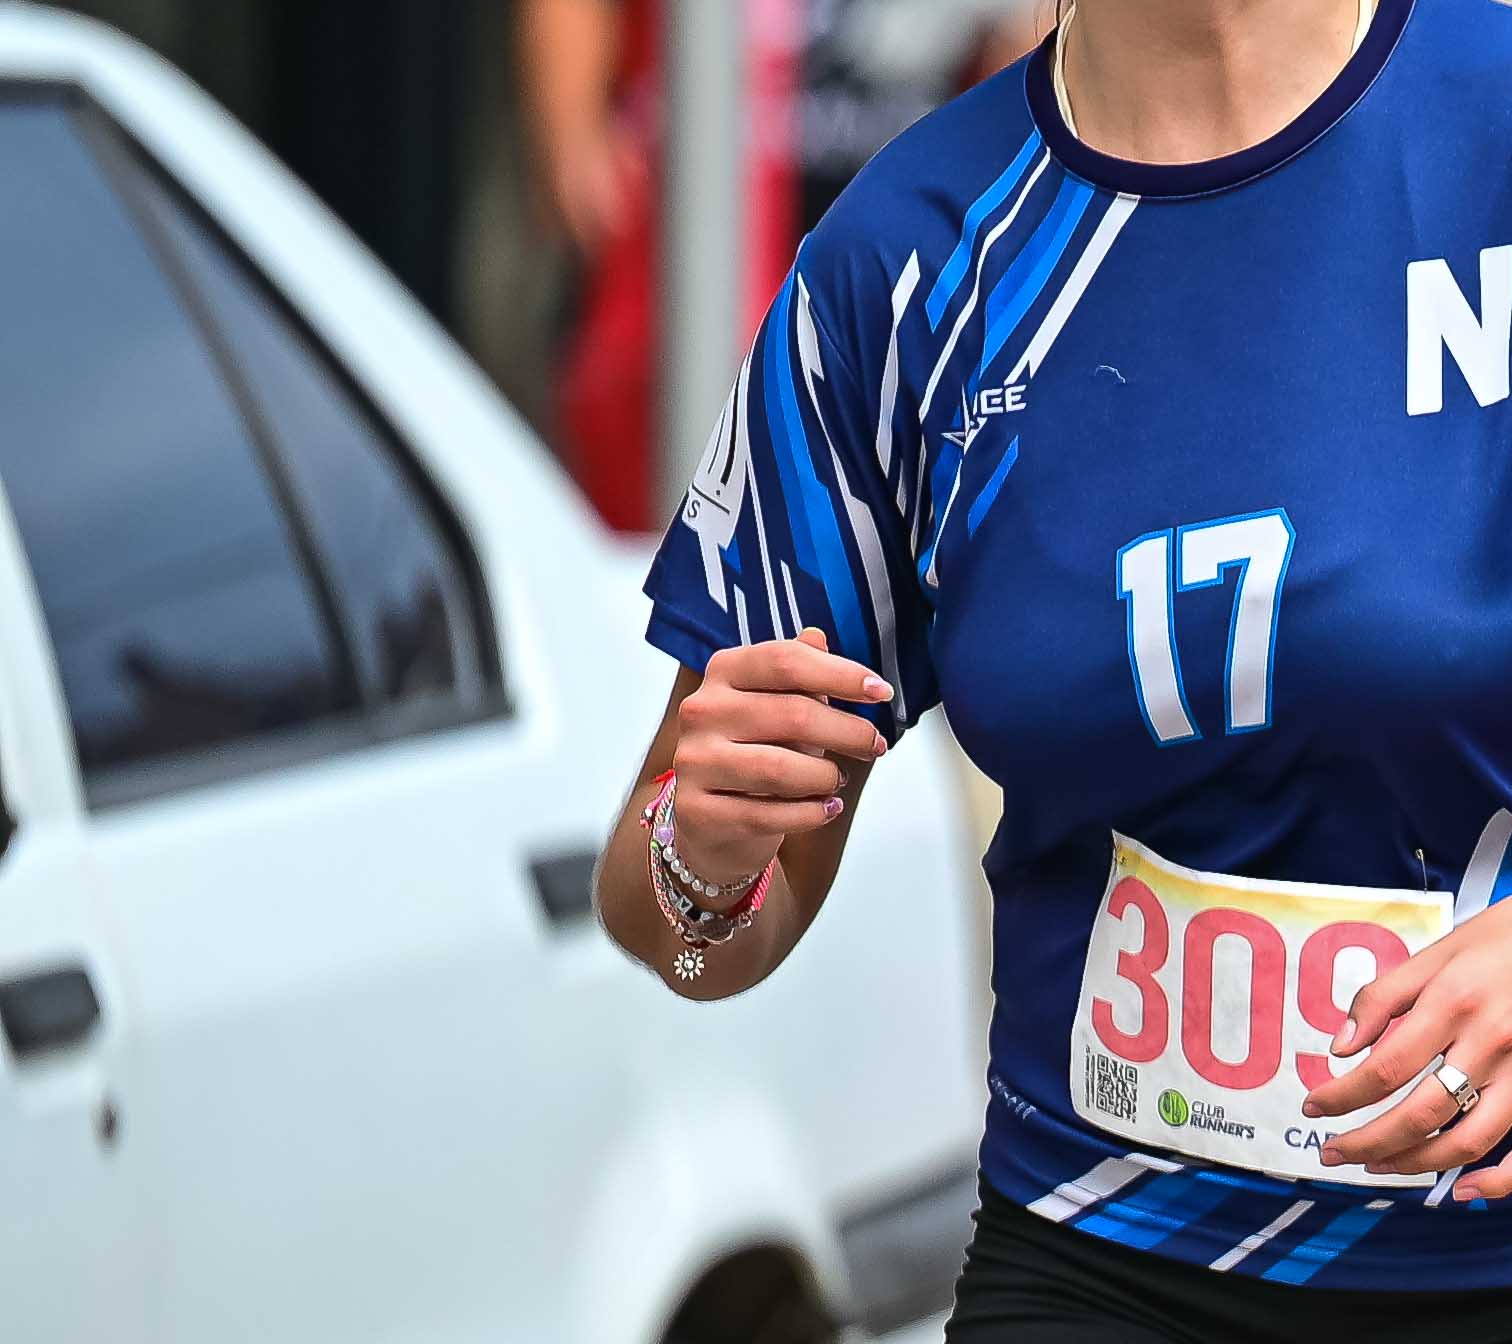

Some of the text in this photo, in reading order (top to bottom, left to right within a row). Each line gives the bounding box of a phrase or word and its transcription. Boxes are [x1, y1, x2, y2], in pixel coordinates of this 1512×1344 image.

[1116, 507, 1297, 748] 17
[1092, 875, 1412, 1090] 309
[1190, 1113, 1256, 1139] RUNNER'S
[1191, 1100, 1225, 1120] CLUB
